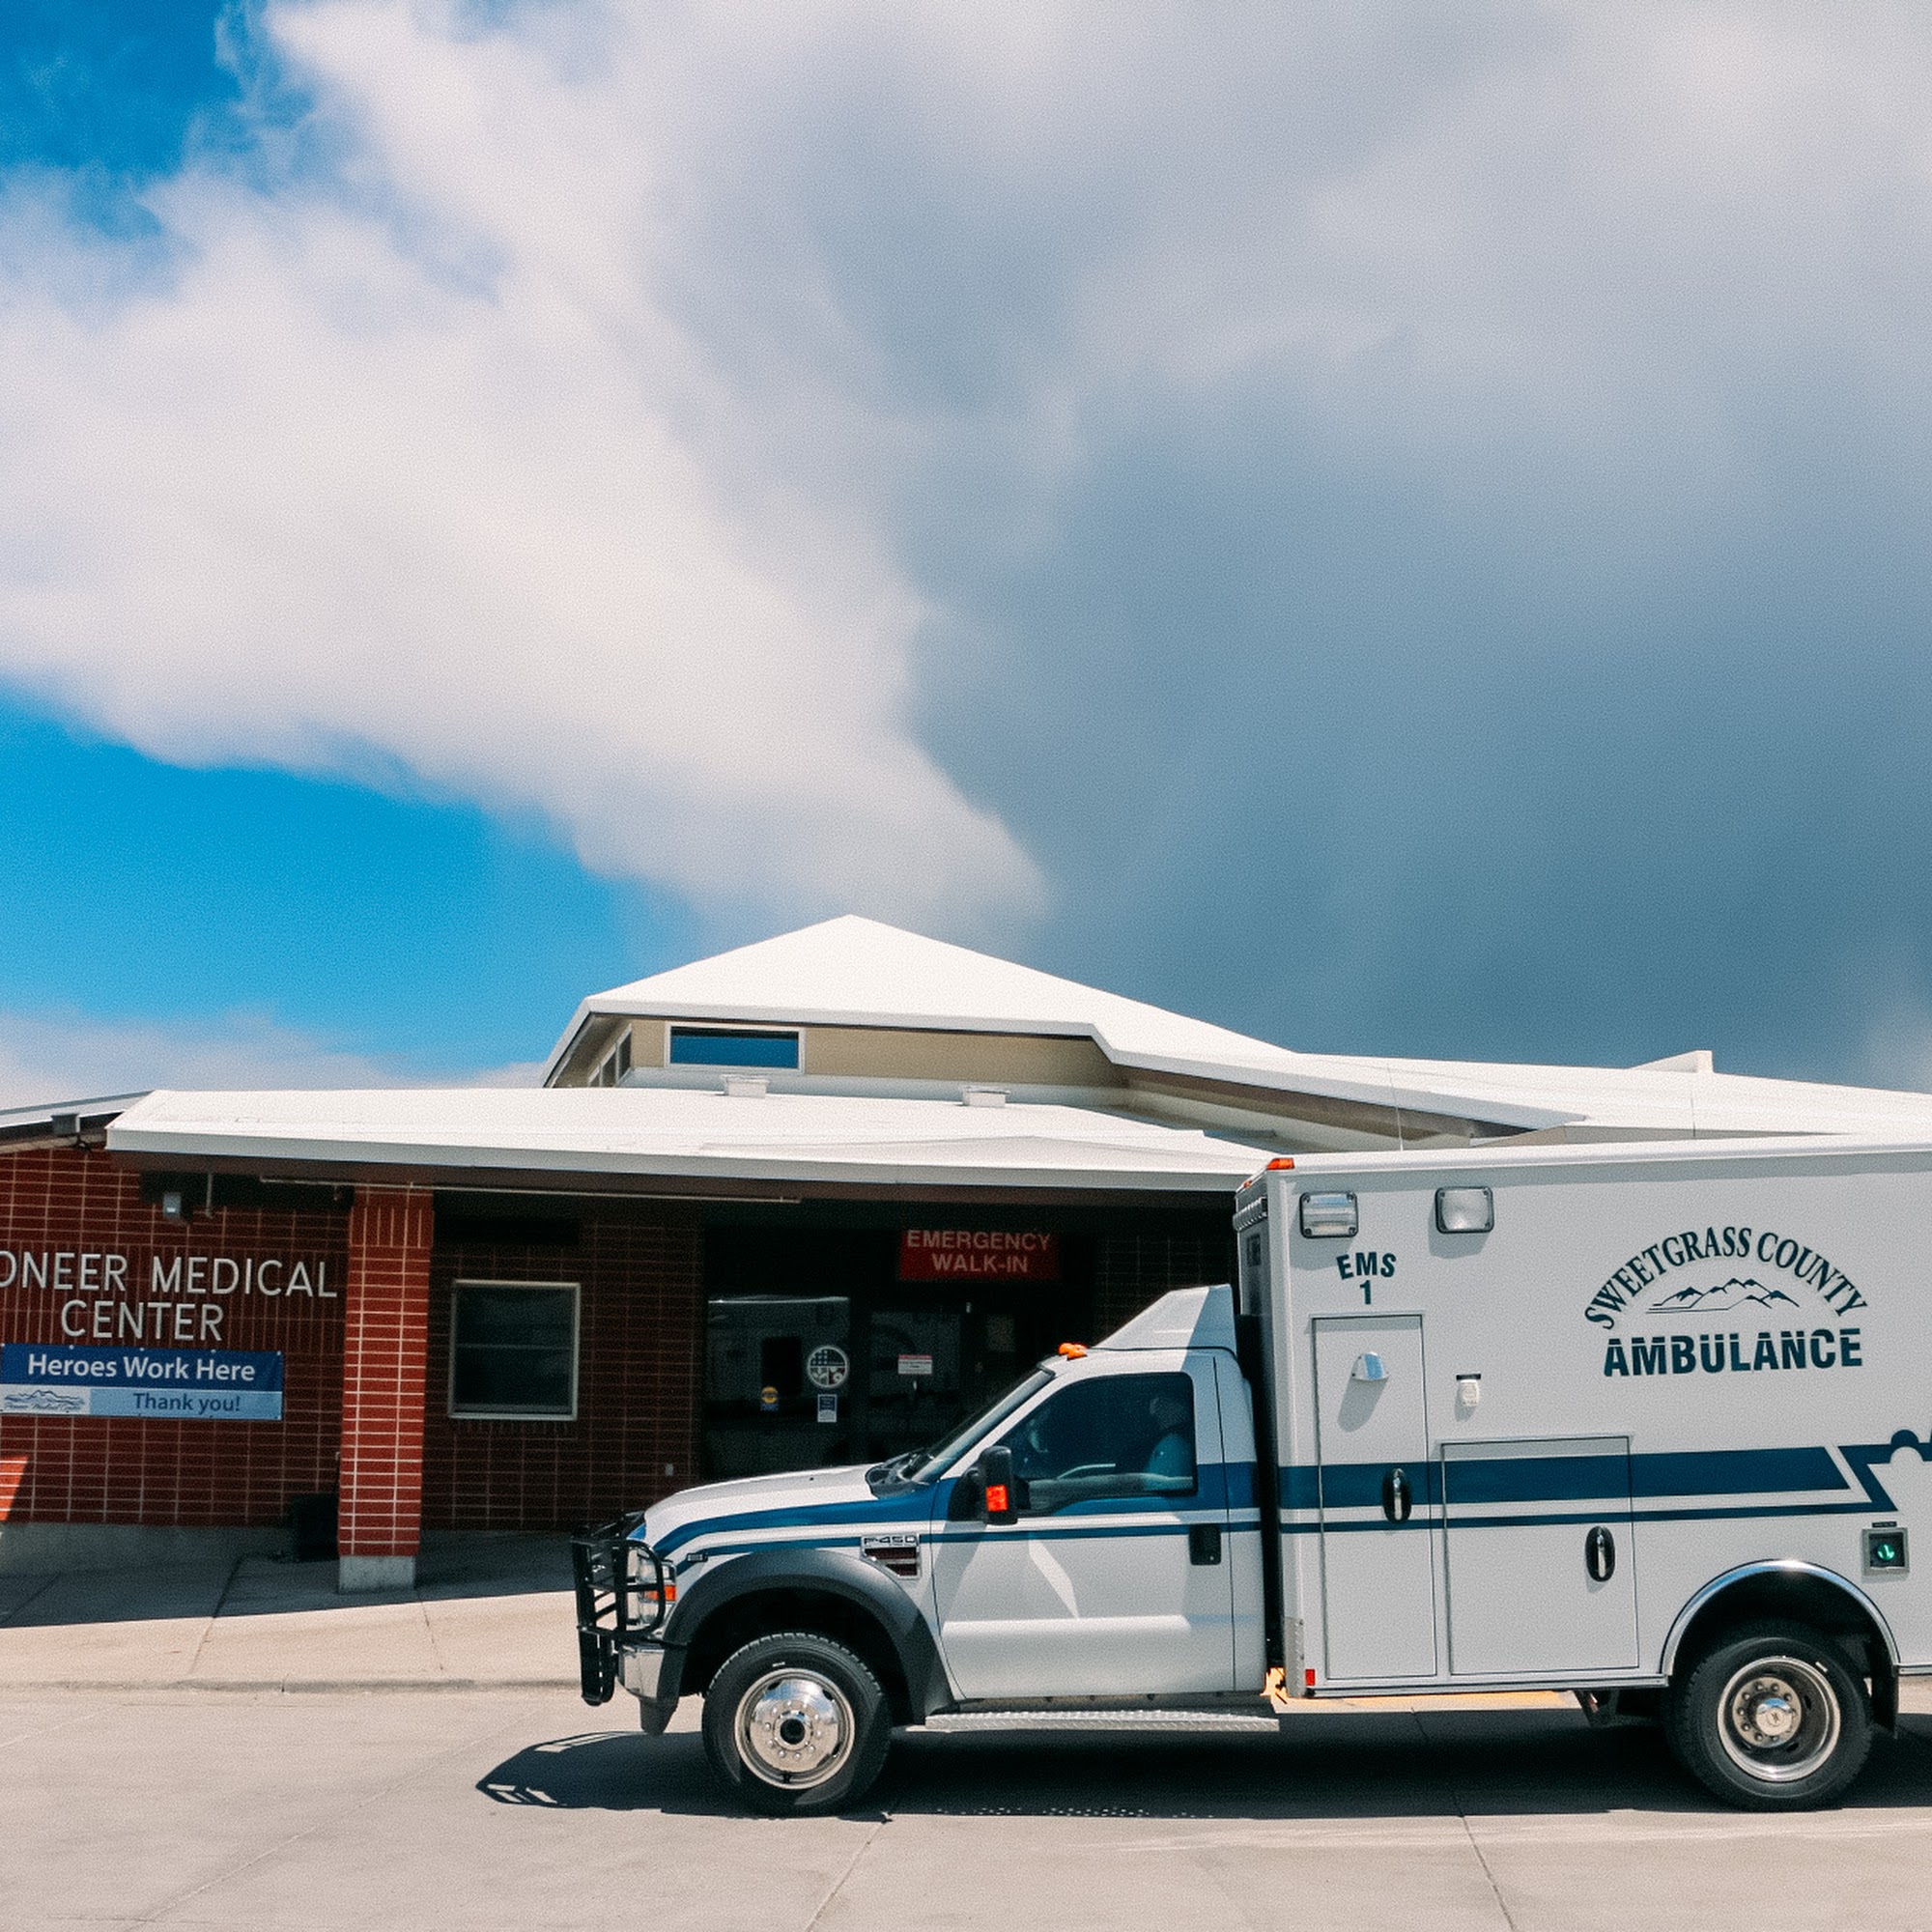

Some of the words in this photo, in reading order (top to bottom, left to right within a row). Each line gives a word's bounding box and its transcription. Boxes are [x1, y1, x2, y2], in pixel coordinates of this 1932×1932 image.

[907, 1230, 1051, 1250] EMERGENCY
[151, 1256, 337, 1298] MEDICAL
[932, 1253, 1029, 1273] WALK-IN
[1336, 1251, 1397, 1280] EMS
[1584, 1226, 1751, 1330] SWEETGRASS
[1757, 1232, 1868, 1317] COUNTY
[1359, 1280, 1372, 1305] 1
[61, 1299, 224, 1341] CENTER
[1604, 1327, 1862, 1377] AMBULANCE
[27, 1353, 117, 1378] Heroes
[124, 1355, 189, 1379] Work
[196, 1358, 256, 1381] Here
[132, 1392, 193, 1410] Thank
[197, 1395, 242, 1416] you!
[863, 1534, 919, 1546] F-450
